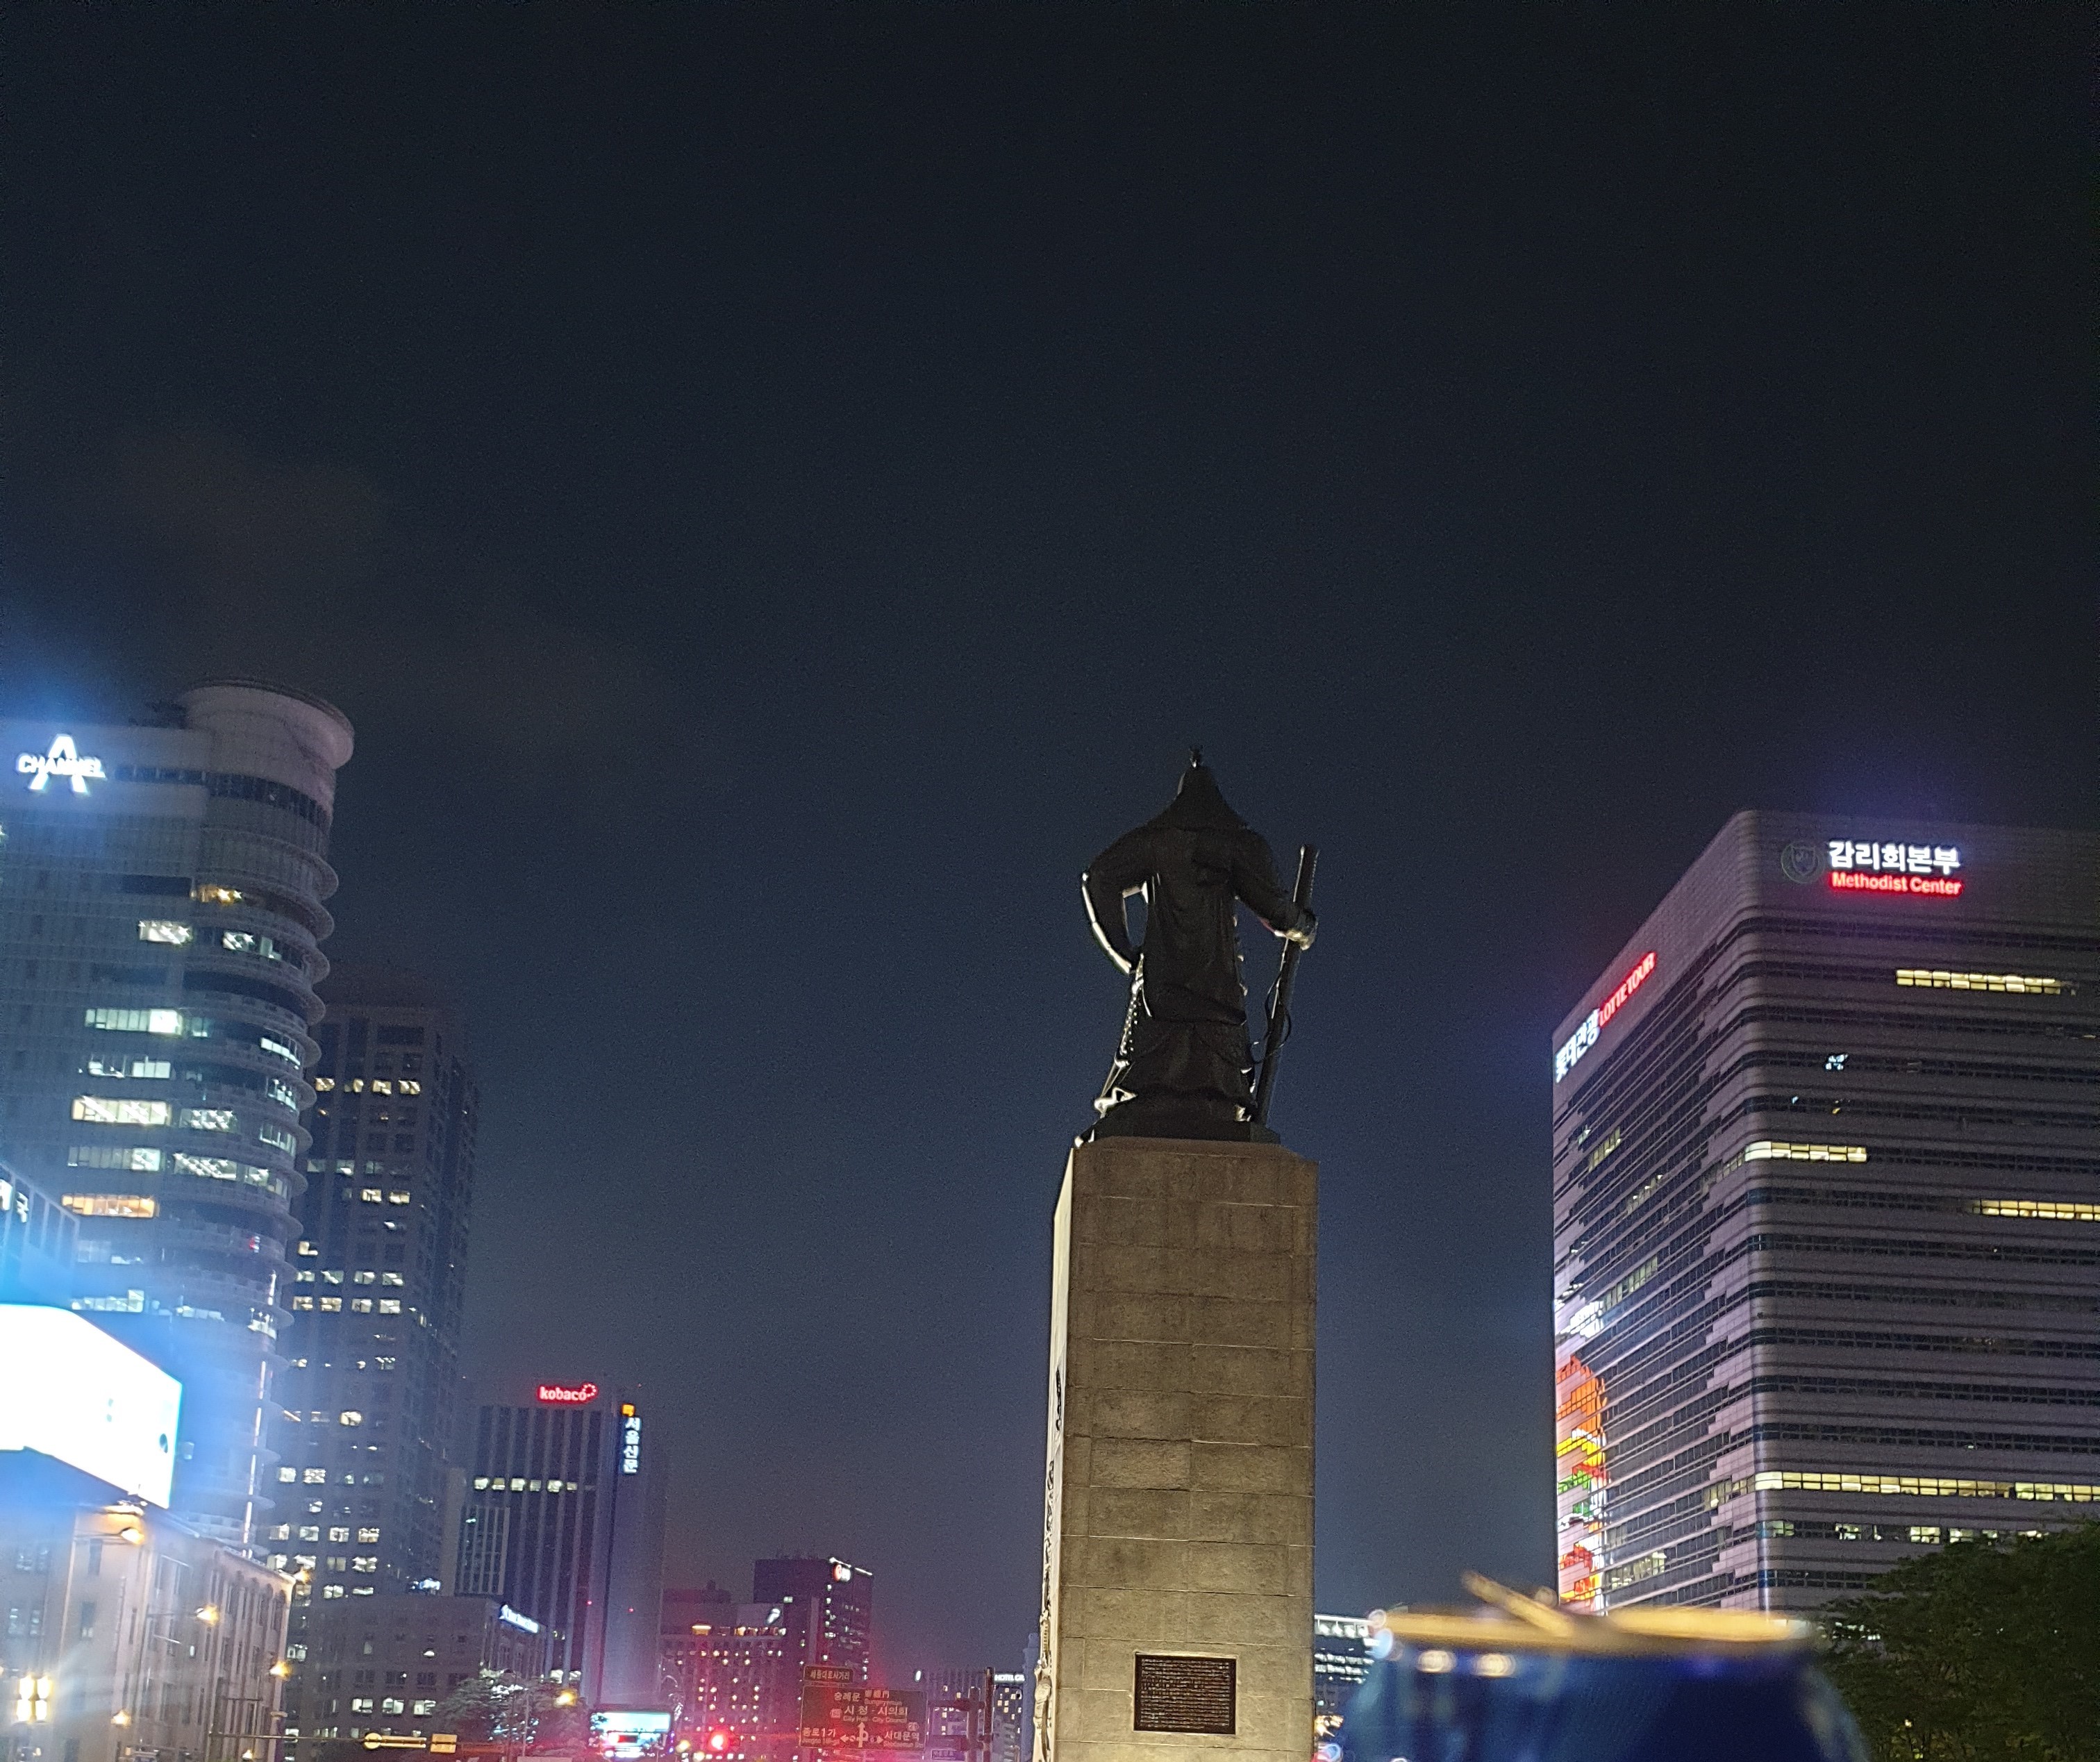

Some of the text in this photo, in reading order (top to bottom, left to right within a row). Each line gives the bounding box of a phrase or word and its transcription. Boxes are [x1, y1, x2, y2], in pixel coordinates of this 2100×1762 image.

[1828, 840, 1961, 875] 감리회본부
[1831, 872, 1962, 895] Methodist Center
[1556, 951, 1656, 1083] 롯데관광 LOTTE TOUR
[540, 1386, 588, 1401] kobaco
[624, 1417, 641, 1474] 서울신문
[877, 1706, 908, 1717] 시의회
